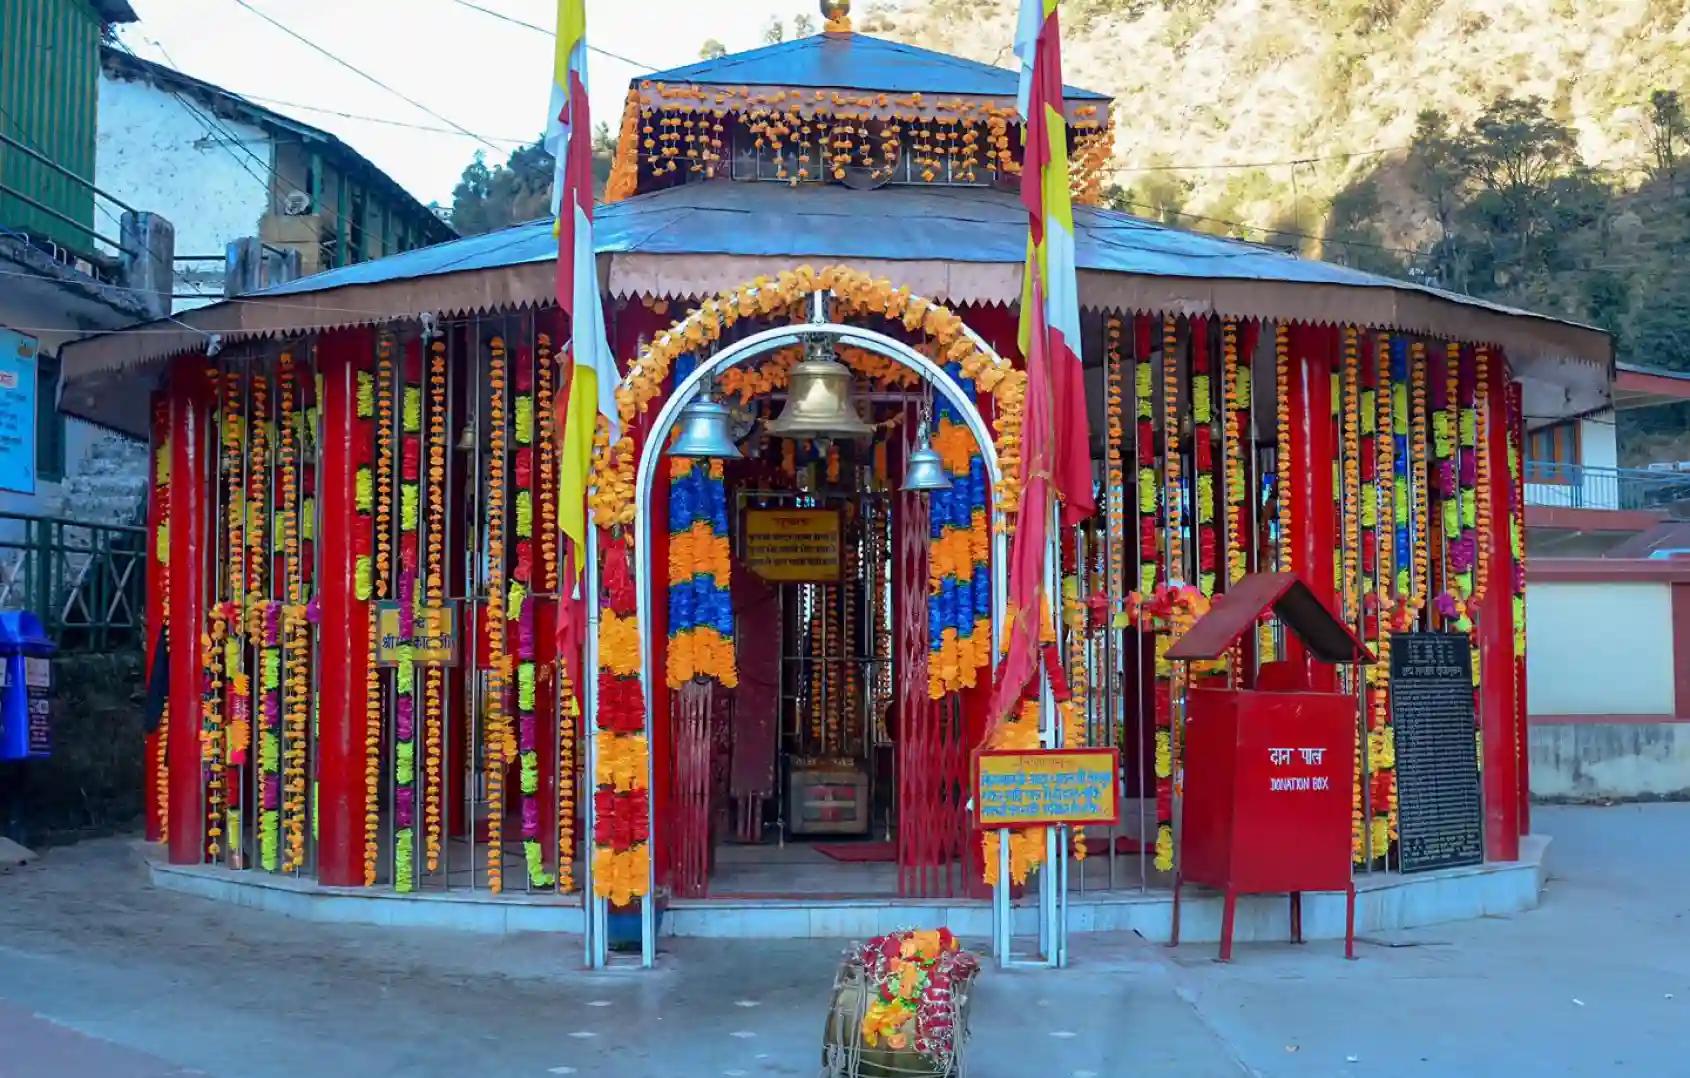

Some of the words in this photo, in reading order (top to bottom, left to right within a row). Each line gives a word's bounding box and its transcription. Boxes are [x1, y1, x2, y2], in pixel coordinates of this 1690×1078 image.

[1268, 748, 1295, 766] दान
[1270, 777, 1310, 792] DONATION
[1312, 776, 1329, 791] BOX
